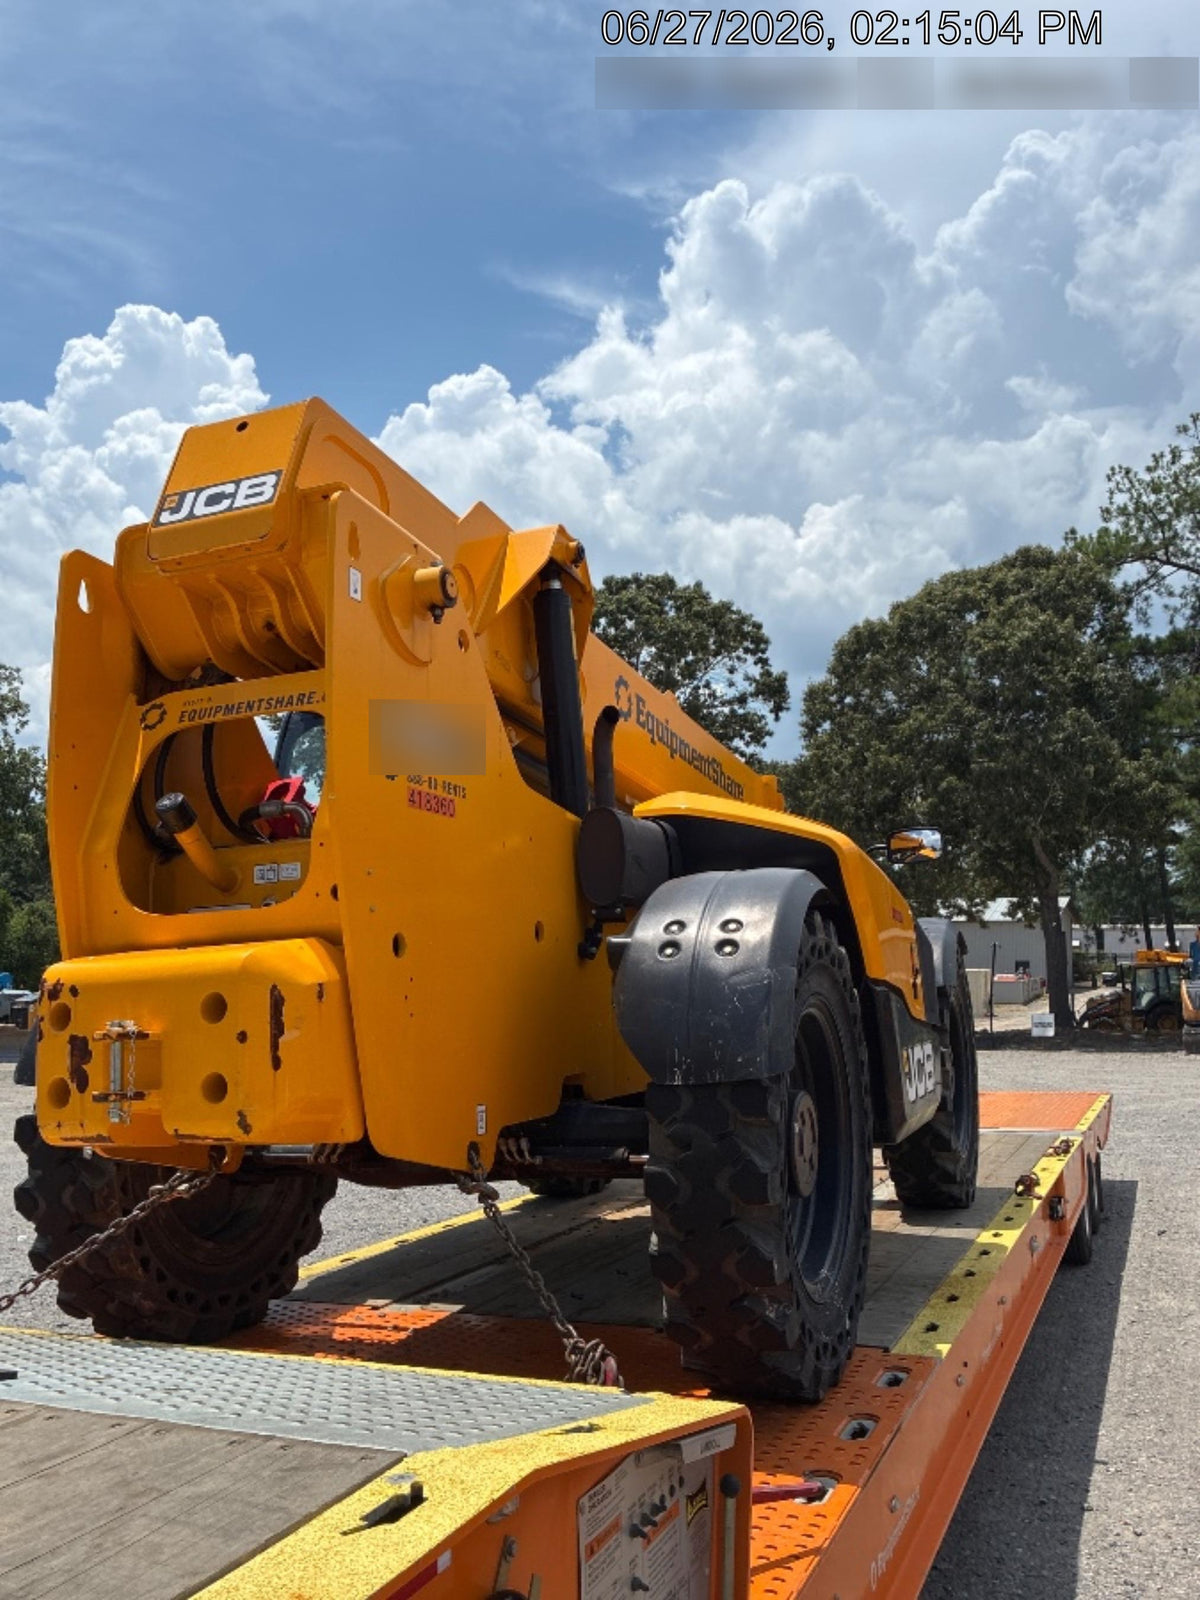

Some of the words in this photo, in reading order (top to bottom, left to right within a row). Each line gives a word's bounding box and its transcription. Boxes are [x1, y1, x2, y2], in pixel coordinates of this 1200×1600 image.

[159, 473, 278, 523] JCB
[635, 693, 744, 801] EquipmentShare
[408, 789, 456, 817] 418360
[906, 1041, 936, 1103] JCB
